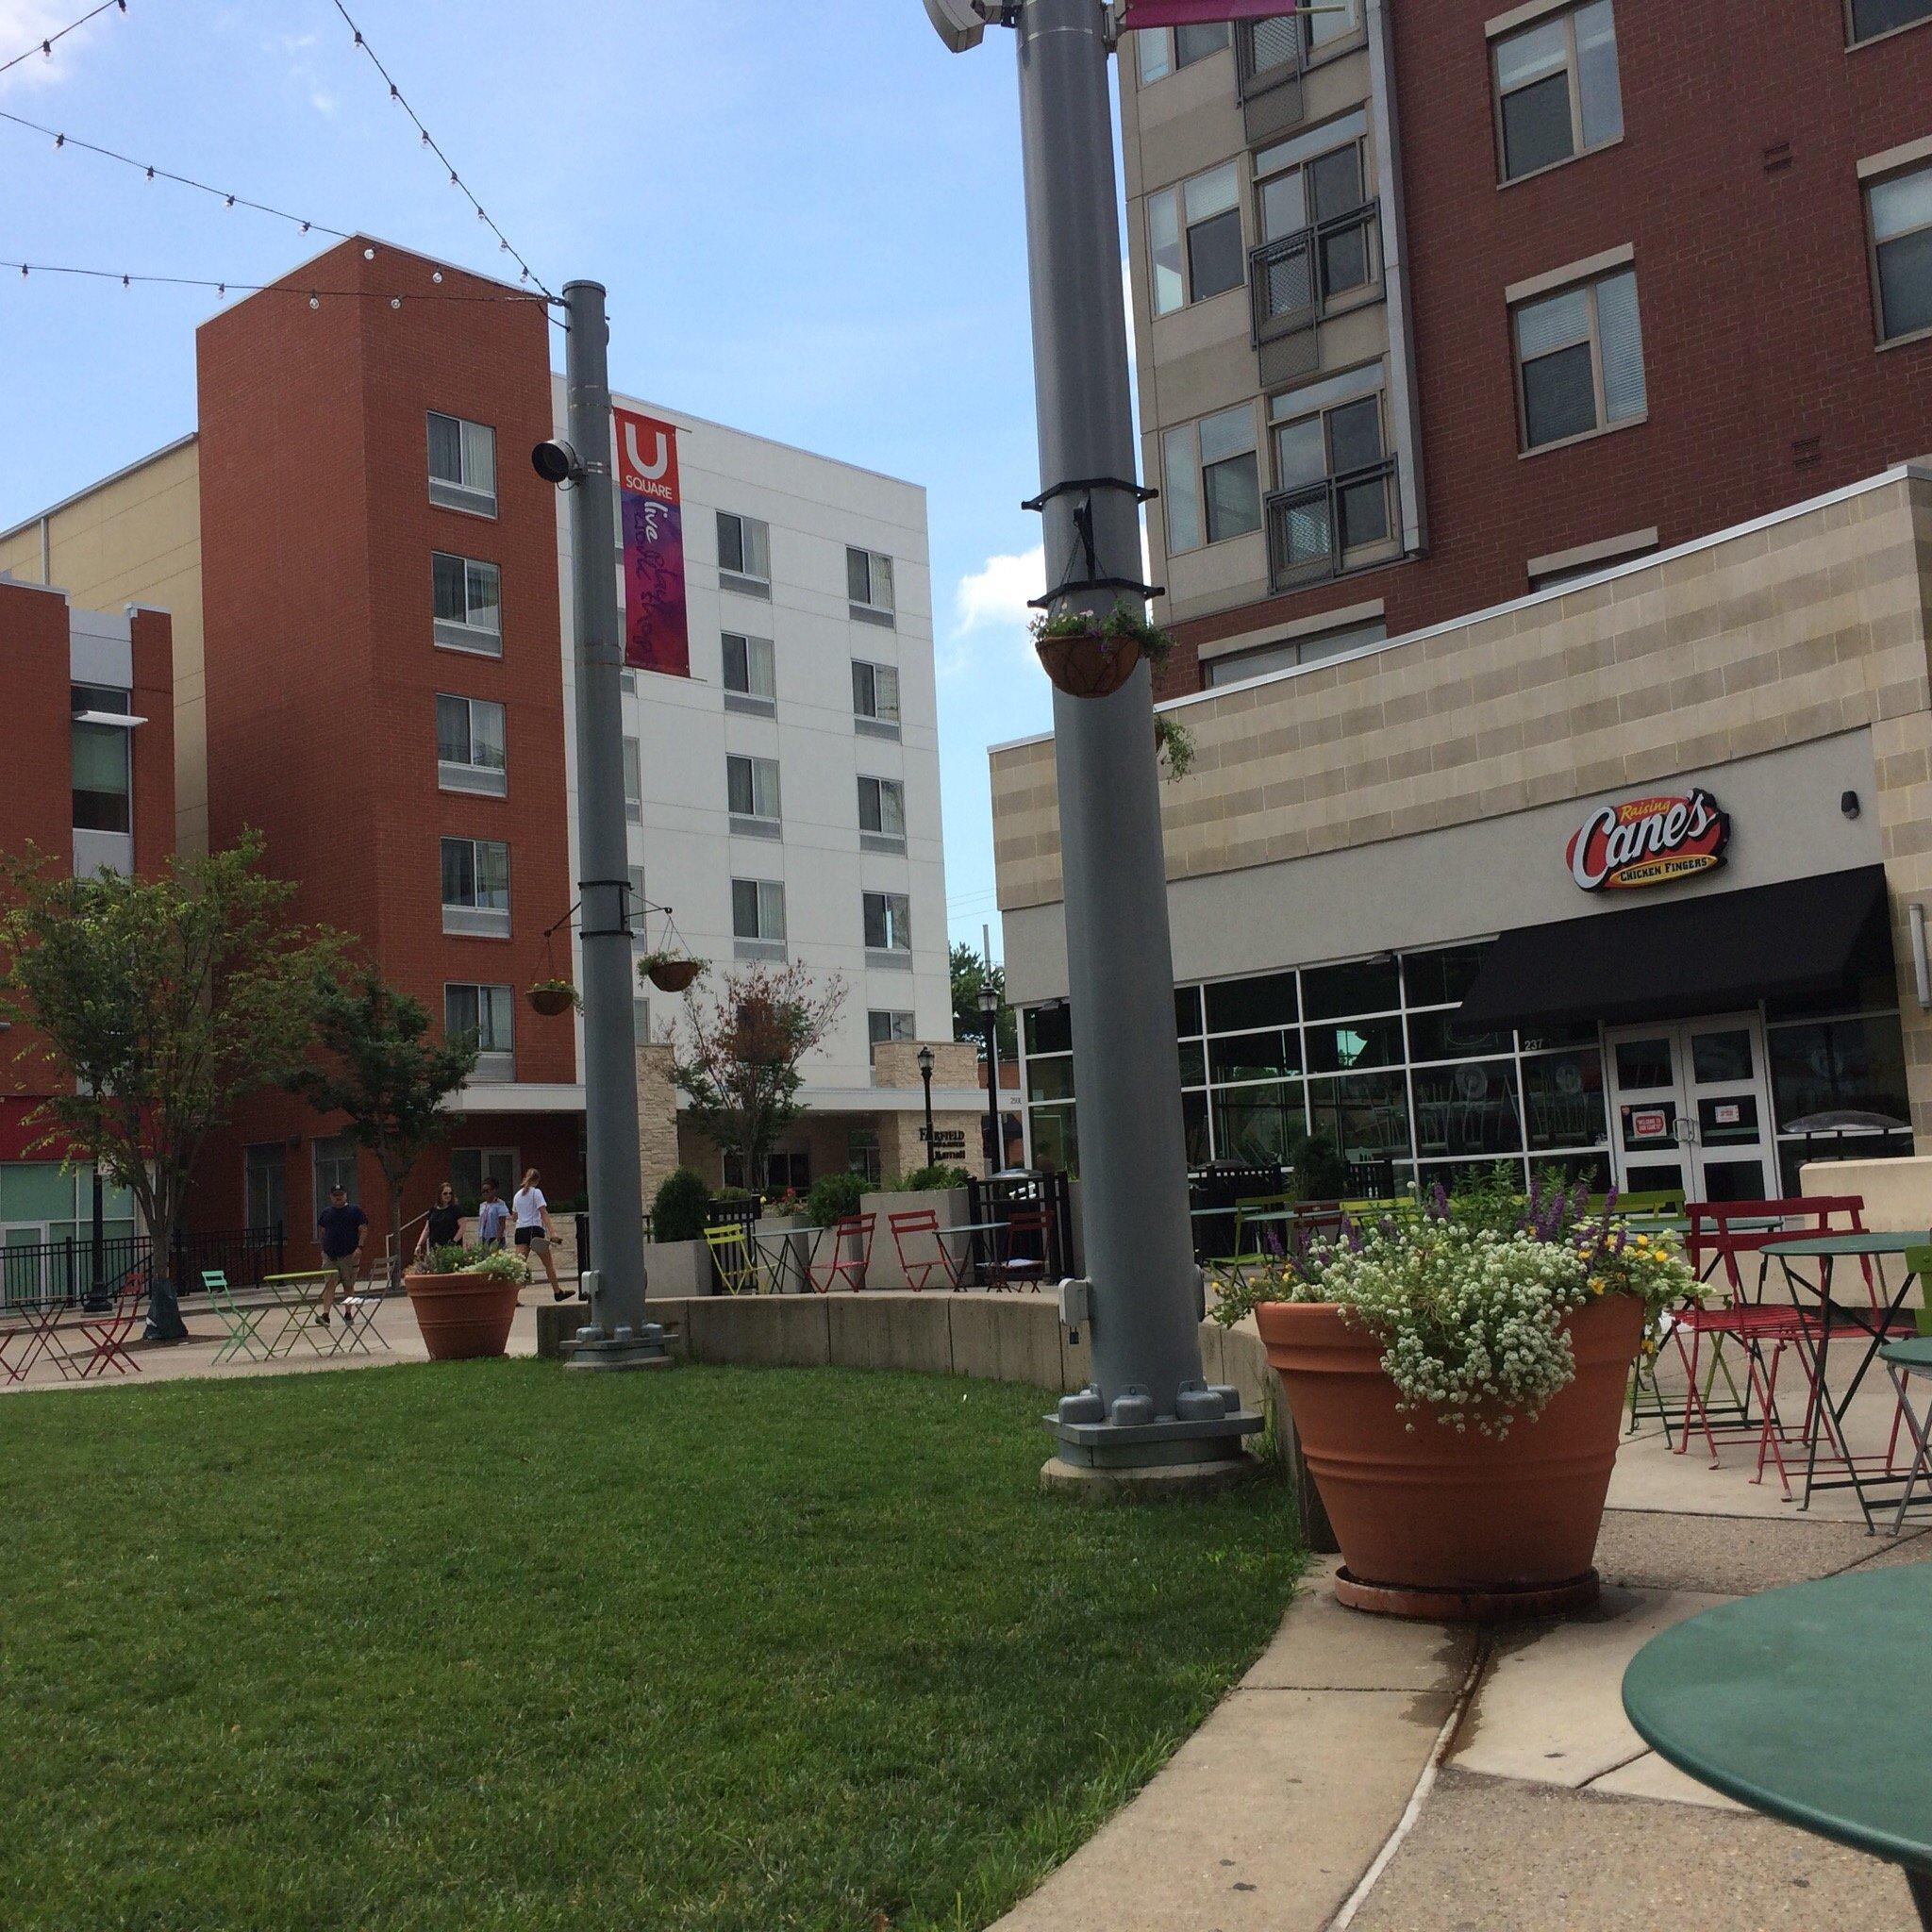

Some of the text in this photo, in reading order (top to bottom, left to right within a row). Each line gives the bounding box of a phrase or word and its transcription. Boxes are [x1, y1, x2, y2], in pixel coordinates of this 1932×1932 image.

[625, 421, 668, 480] U
[625, 475, 673, 500] SQUARE
[643, 501, 668, 542] live
[1620, 799, 1671, 821] Raising
[1573, 790, 1719, 889] Cane's
[1620, 858, 1708, 882] CHICKEN FINGERS
[1524, 1038, 1543, 1051] 237
